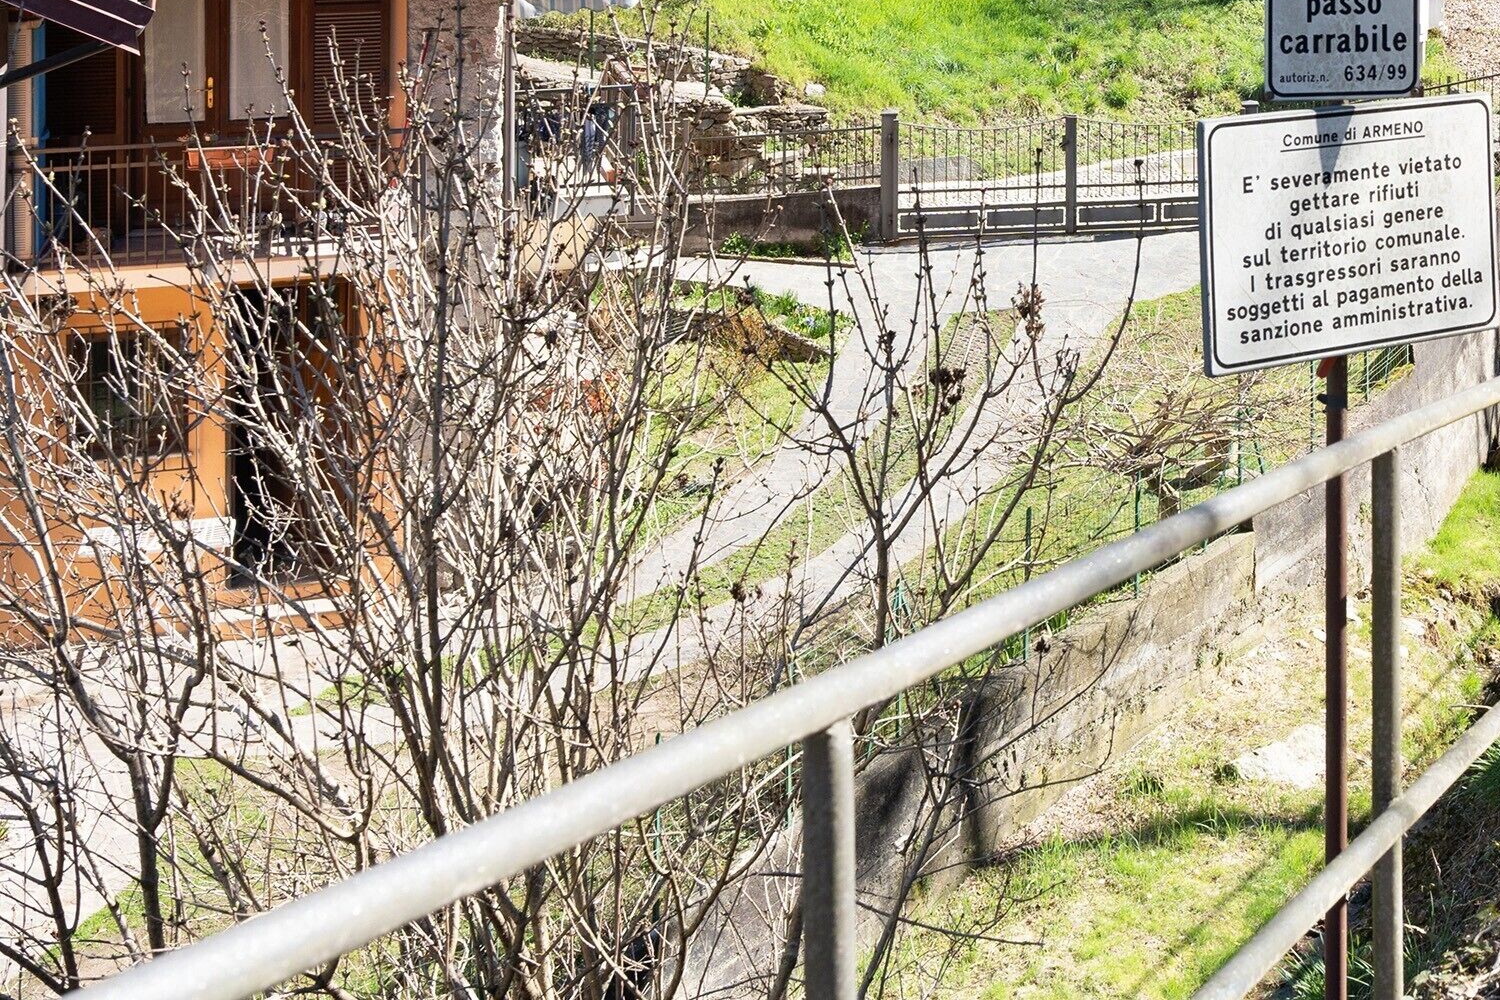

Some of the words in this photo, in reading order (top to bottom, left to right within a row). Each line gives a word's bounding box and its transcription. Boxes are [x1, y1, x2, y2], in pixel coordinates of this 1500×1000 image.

[1280, 24, 1407, 54] carrabile
[1279, 72, 1329, 83] autoriz.n.
[1344, 64, 1407, 82] 634/99
[1282, 130, 1339, 147] Comune
[1344, 127, 1357, 140] di
[1362, 120, 1424, 139] ARMENO
[1270, 162, 1391, 191] severamente
[1398, 154, 1463, 176] vietato
[1289, 193, 1360, 216] gettare
[1369, 180, 1420, 203] rifiuti
[1264, 223, 1282, 241] di
[1290, 211, 1375, 240] qualsiasi
[1383, 206, 1444, 227] genere
[1242, 250, 1272, 268] sul
[1280, 236, 1367, 264] territorio
[1376, 224, 1466, 250] comunale.
[1250, 275, 1255, 292] I
[1265, 260, 1382, 290] trasgressori
[1390, 249, 1461, 273] saranno
[1226, 294, 1305, 323] soggetti
[1312, 289, 1330, 309] al
[1336, 275, 1435, 308] pagamento
[1441, 267, 1483, 289] della
[1240, 321, 1323, 344] sanzione
[1332, 296, 1474, 330] amministrativa.
